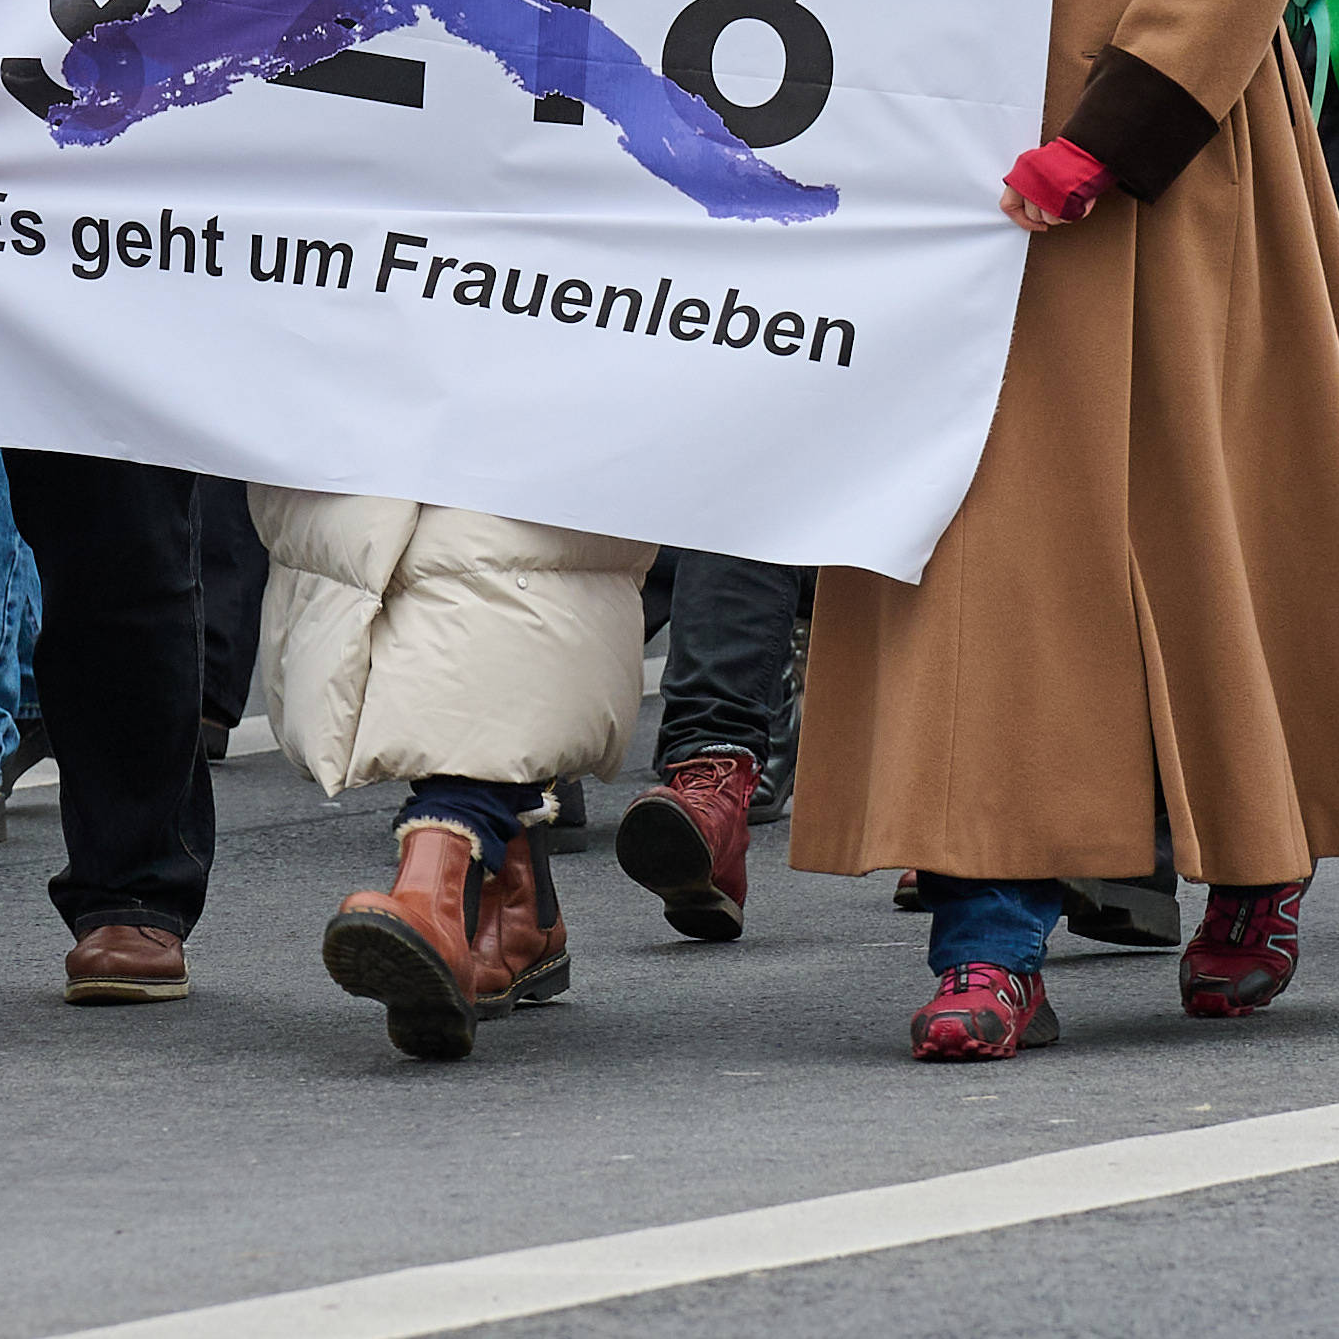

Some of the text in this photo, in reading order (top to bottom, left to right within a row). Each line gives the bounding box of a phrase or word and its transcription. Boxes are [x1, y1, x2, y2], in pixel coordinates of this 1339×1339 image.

[71, 209, 226, 280] geht
[250, 231, 355, 290] um
[375, 231, 857, 368] Frauenleben
